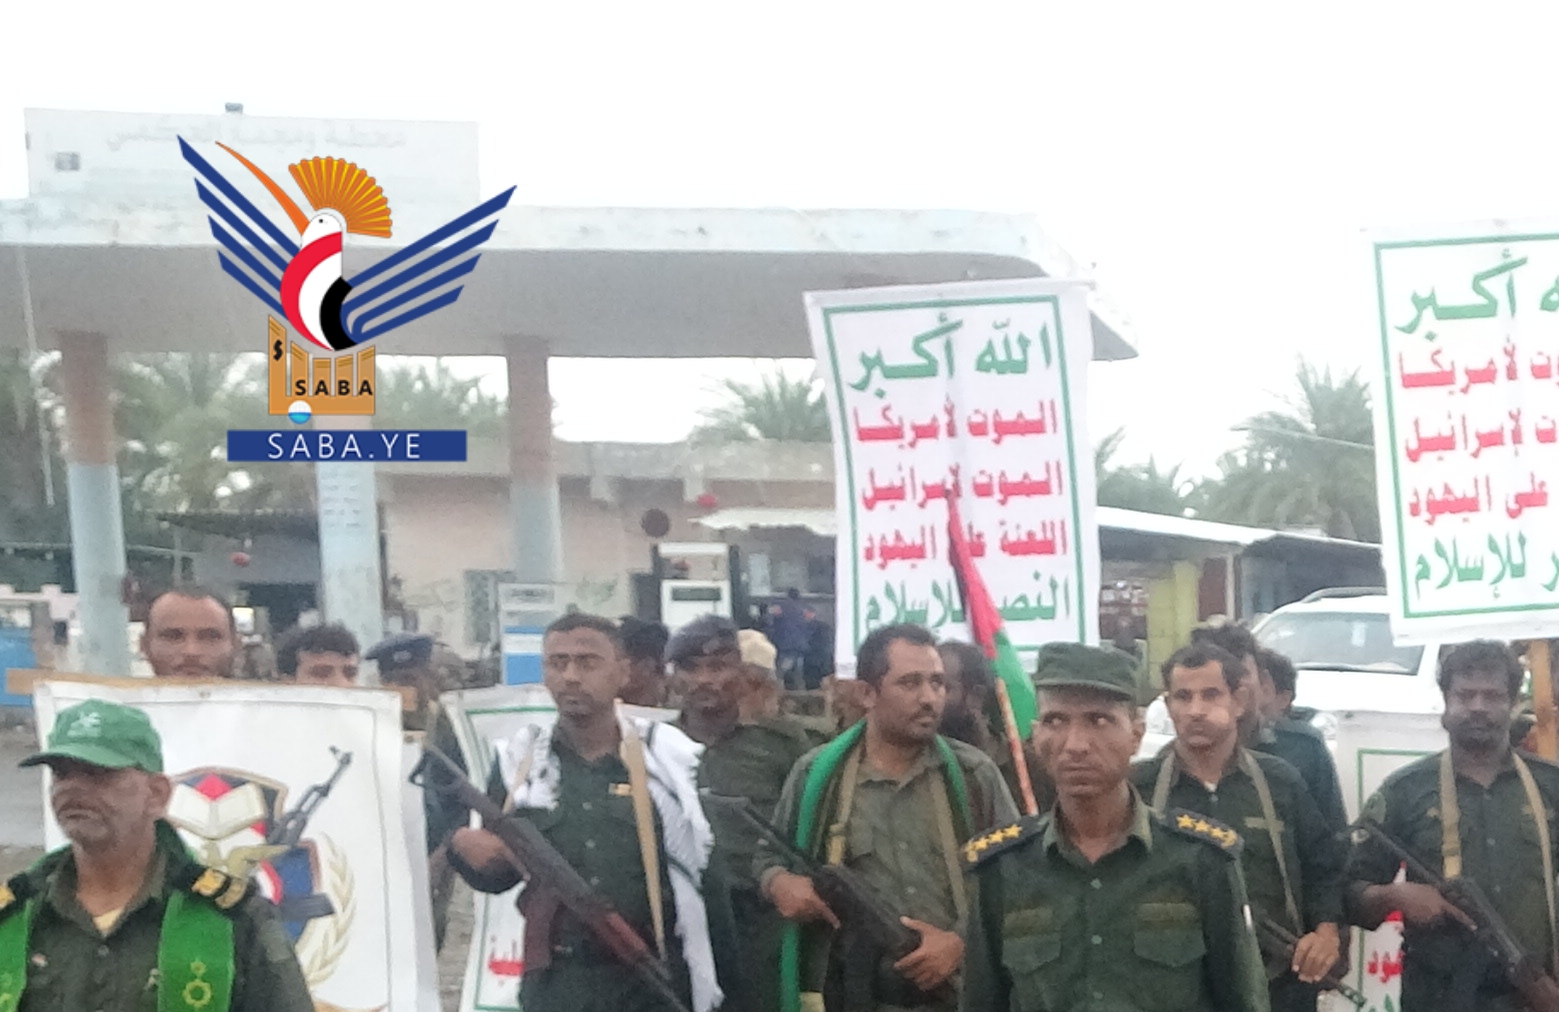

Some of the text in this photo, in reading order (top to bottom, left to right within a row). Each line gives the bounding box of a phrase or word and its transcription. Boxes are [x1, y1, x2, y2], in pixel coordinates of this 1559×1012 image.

[1394, 248, 1529, 342] أكبر
[849, 312, 1053, 399] الله أكبر
[1398, 335, 1519, 396] لأمريكا
[967, 397, 1058, 446] الموت
[972, 459, 1063, 507] الموت
[1409, 473, 1494, 526] اليهود
[1505, 470, 1549, 519] على
[863, 522, 937, 570] اليهود
[1000, 518, 1069, 558] اللعنة
[1414, 528, 1529, 600] للإسلام
[998, 569, 1071, 622] النص
